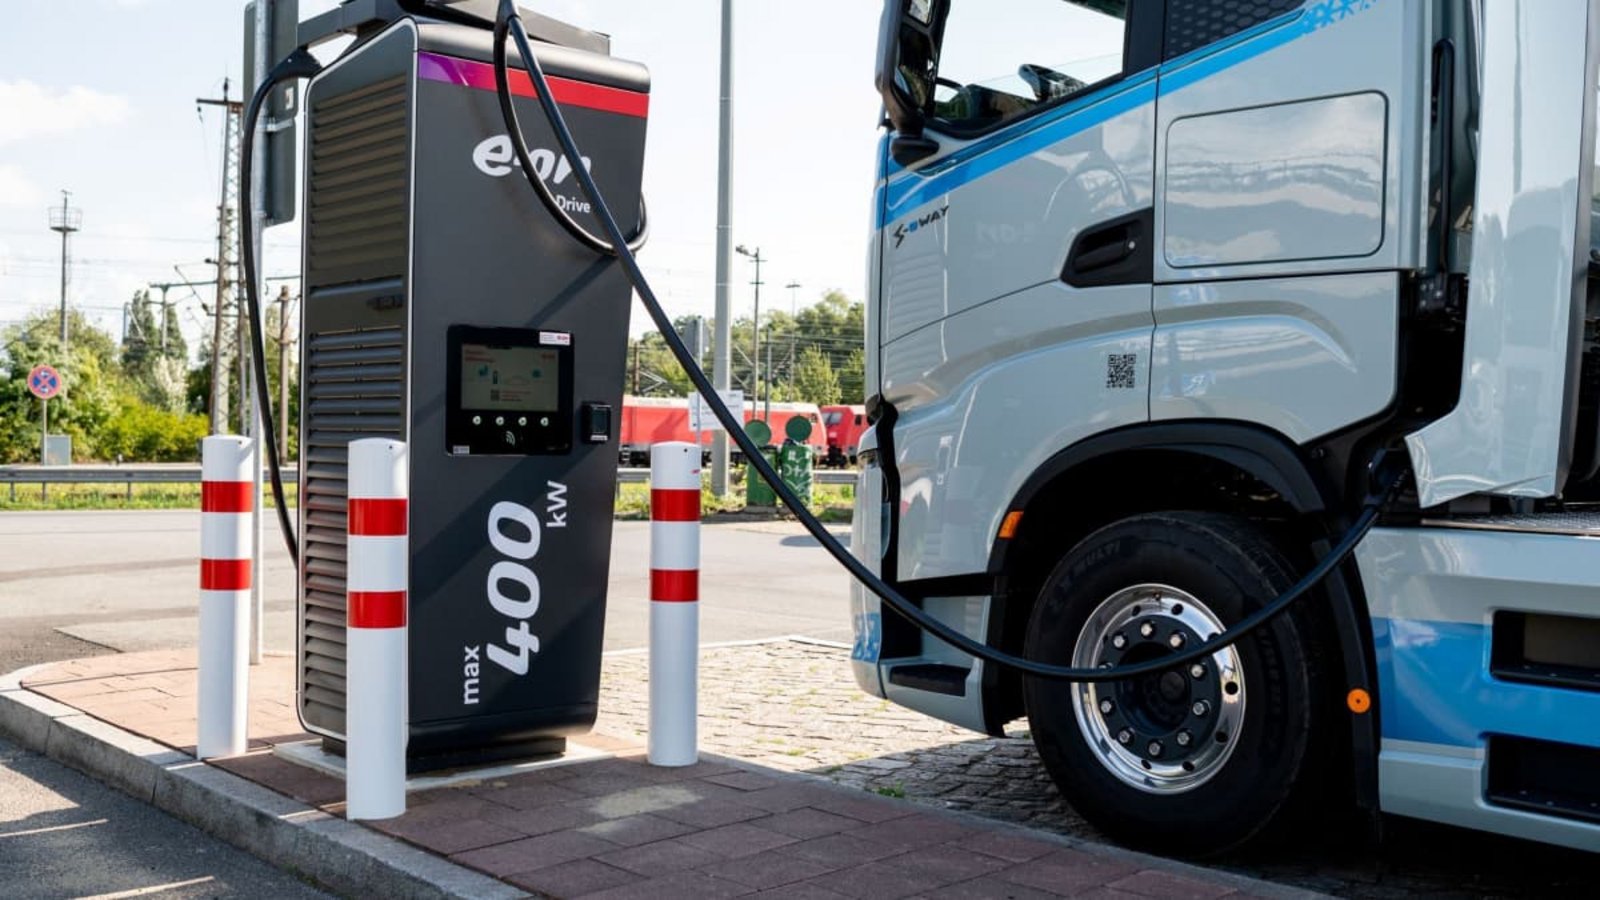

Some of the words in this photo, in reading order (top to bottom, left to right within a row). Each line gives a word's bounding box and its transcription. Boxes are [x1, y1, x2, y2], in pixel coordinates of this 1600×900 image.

[555, 194, 591, 213] Drive
[546, 480, 568, 527] kW
[486, 501, 541, 675] 400
[463, 645, 480, 705] max
